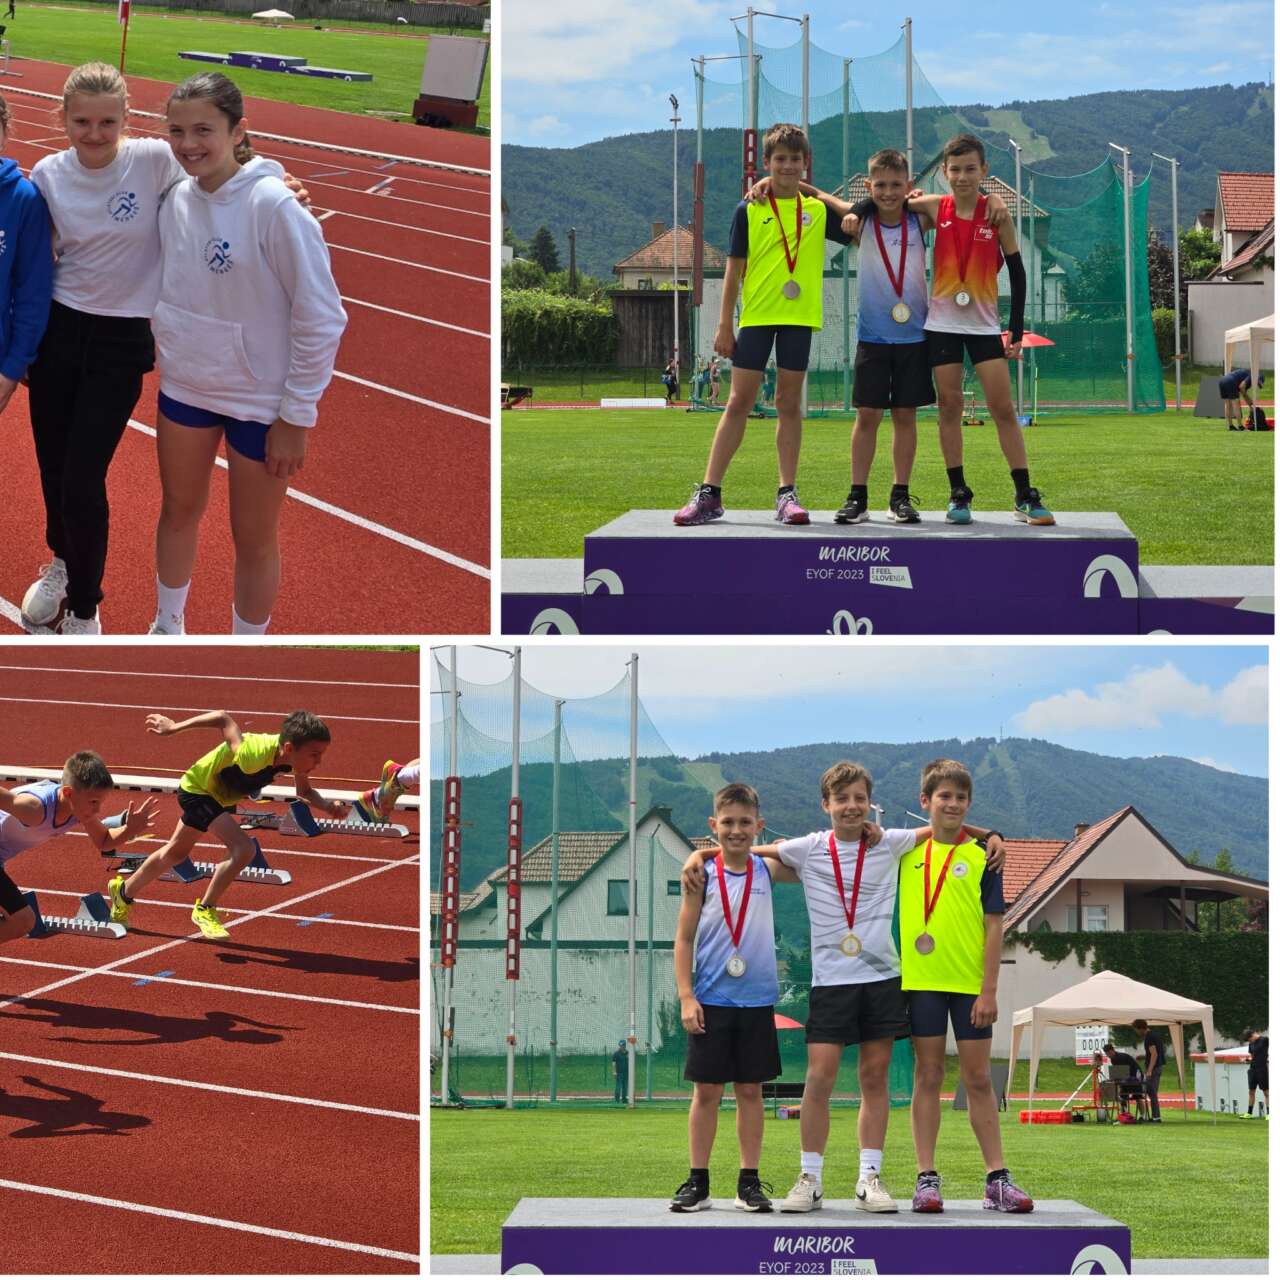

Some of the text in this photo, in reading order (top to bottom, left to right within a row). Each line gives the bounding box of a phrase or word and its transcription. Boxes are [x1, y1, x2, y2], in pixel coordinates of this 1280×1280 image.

[819, 546, 891, 563] MARIBOR
[806, 568, 864, 580] EYOF 2023
[773, 1236, 855, 1255] MARIBOR
[759, 1261, 825, 1274] EYOF 2023
